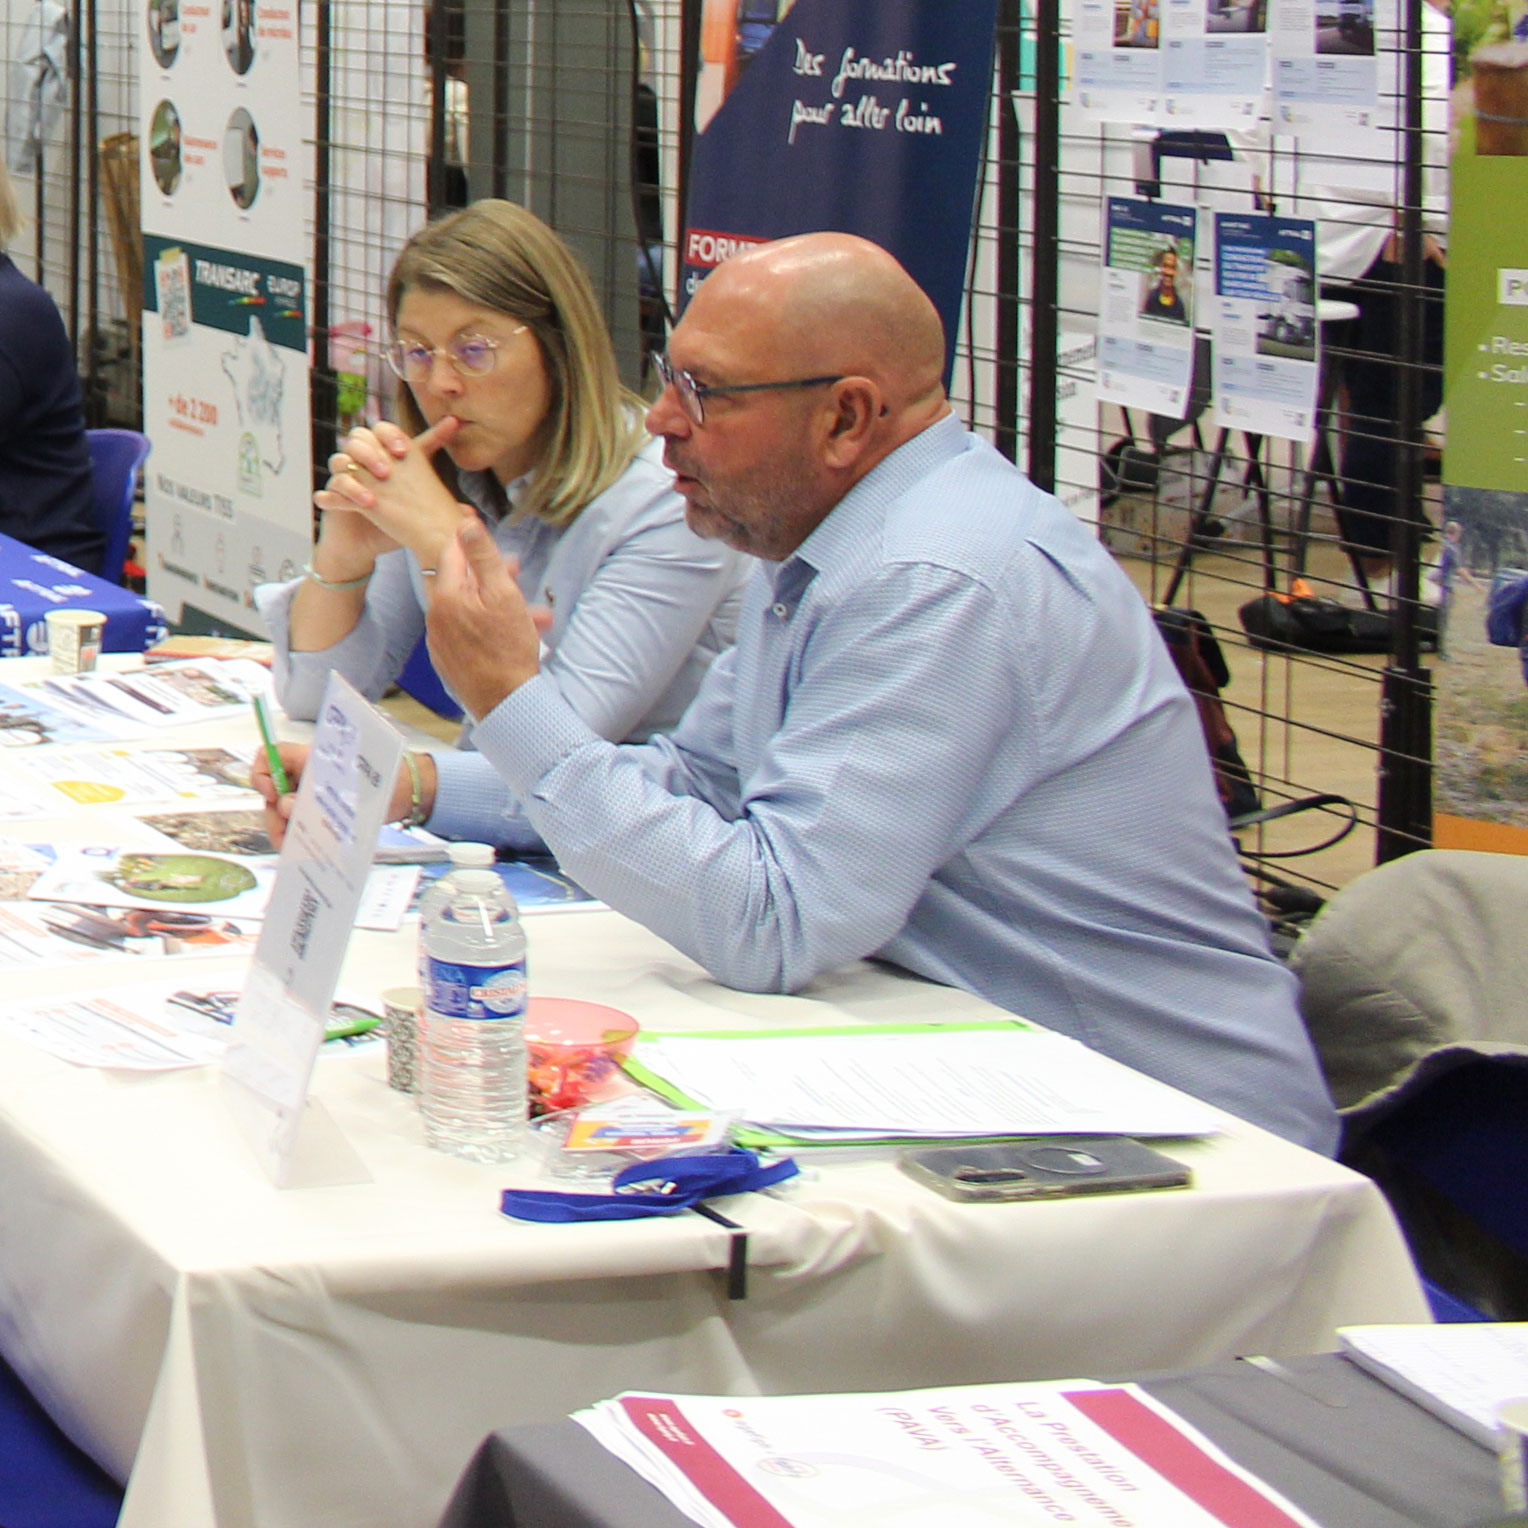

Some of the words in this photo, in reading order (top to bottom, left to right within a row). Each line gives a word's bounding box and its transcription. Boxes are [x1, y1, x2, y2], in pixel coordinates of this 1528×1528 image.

[792, 37, 826, 77] Des
[831, 46, 958, 99] formations
[788, 98, 836, 145] pour
[840, 94, 891, 130] aller
[895, 97, 943, 136] loin
[195, 258, 261, 296] TRANSARC
[873, 1406, 951, 1452] (PAVA)
[1015, 1401, 1048, 1420] La
[1041, 1421, 1141, 1493] Prestation
[927, 1405, 973, 1435] Vers
[962, 1437, 1078, 1523] l'Alternance
[969, 1403, 1135, 1528] d'Accompagneme
